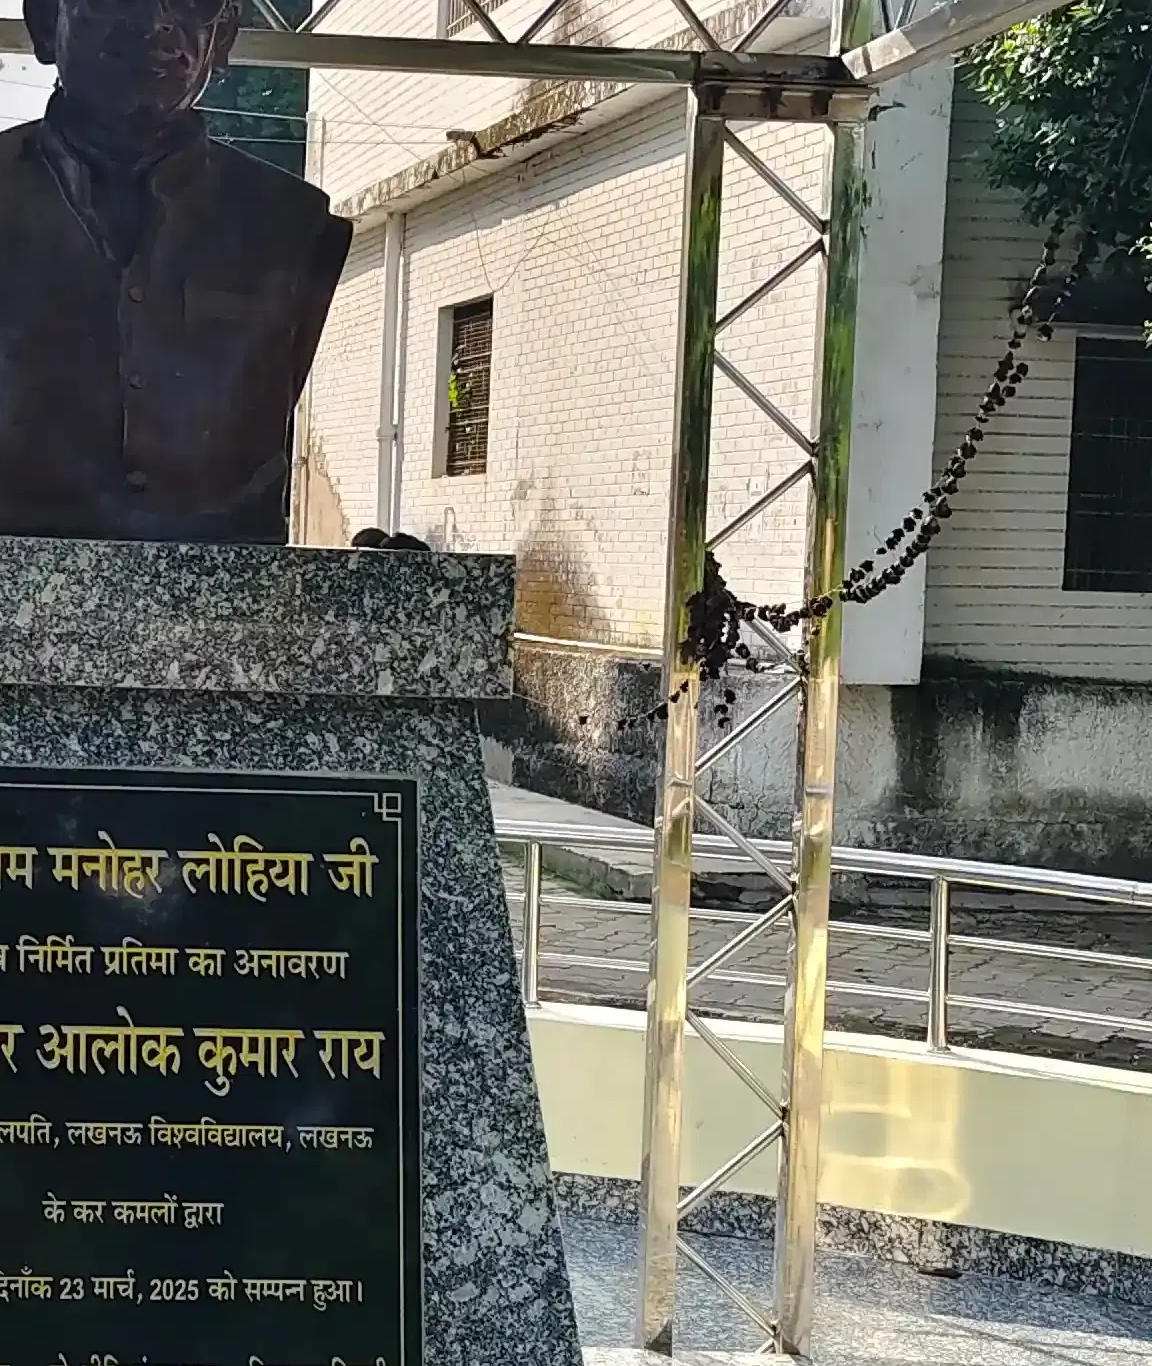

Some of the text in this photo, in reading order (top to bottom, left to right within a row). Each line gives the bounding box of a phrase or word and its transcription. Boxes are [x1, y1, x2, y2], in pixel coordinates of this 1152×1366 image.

[47, 831, 168, 898] मनोहर
[177, 833, 314, 901] लोहिया
[323, 838, 378, 897] जी
[16, 935, 94, 973] निर्मित
[101, 937, 179, 975] प्रतिमा
[185, 949, 225, 975] का
[235, 950, 349, 978] अनावरण
[37, 1007, 184, 1075] आलोक
[193, 1028, 304, 1096] कुमार
[314, 1031, 385, 1078] राय
[66, 1123, 143, 1144] लखनऊ
[148, 1116, 291, 1151] विश्वविद्यालय,
[297, 1127, 374, 1148] लखनऊ
[43, 1192, 224, 1228] के कर कमलों द्वारा
[60, 1279, 83, 1299] 23
[91, 1269, 142, 1303] मार्च,
[150, 1279, 198, 1300] 2025
[207, 1270, 237, 1300] को
[243, 1279, 306, 1301] सम्पन्न
